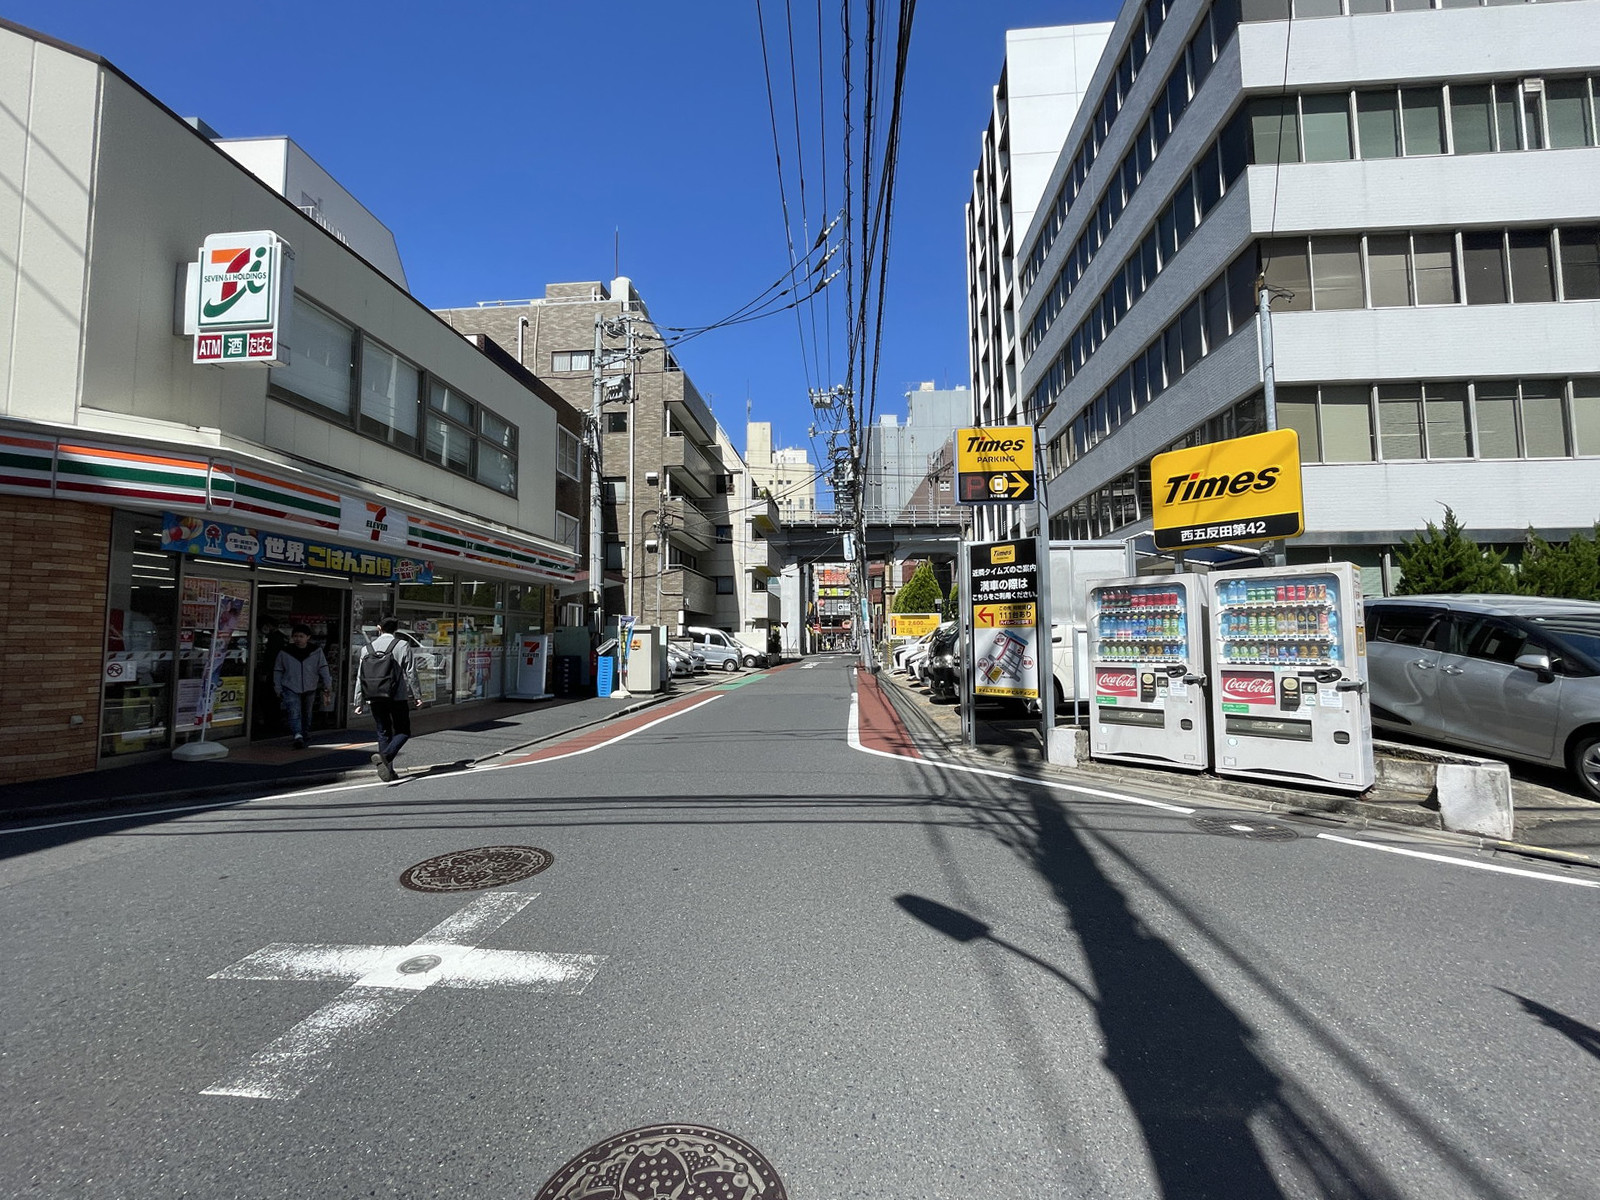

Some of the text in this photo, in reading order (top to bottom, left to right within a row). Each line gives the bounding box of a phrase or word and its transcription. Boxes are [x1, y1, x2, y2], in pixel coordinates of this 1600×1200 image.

[232, 271, 267, 281] HOLDINGS
[199, 339, 221, 356] ATM
[227, 337, 243, 355] 酒
[249, 336, 272, 353] たばこ
[967, 437, 1025, 452] Times
[977, 455, 1015, 463] PARKING
[1165, 466, 1280, 504] Times
[1180, 521, 1267, 542] 西五反田第42
[980, 577, 1028, 592] 満車の際は
[972, 590, 1039, 602] こちらをご利用ください。
[1098, 673, 1136, 687] Coca-Cola
[1225, 677, 1274, 694] Coca-Cola
